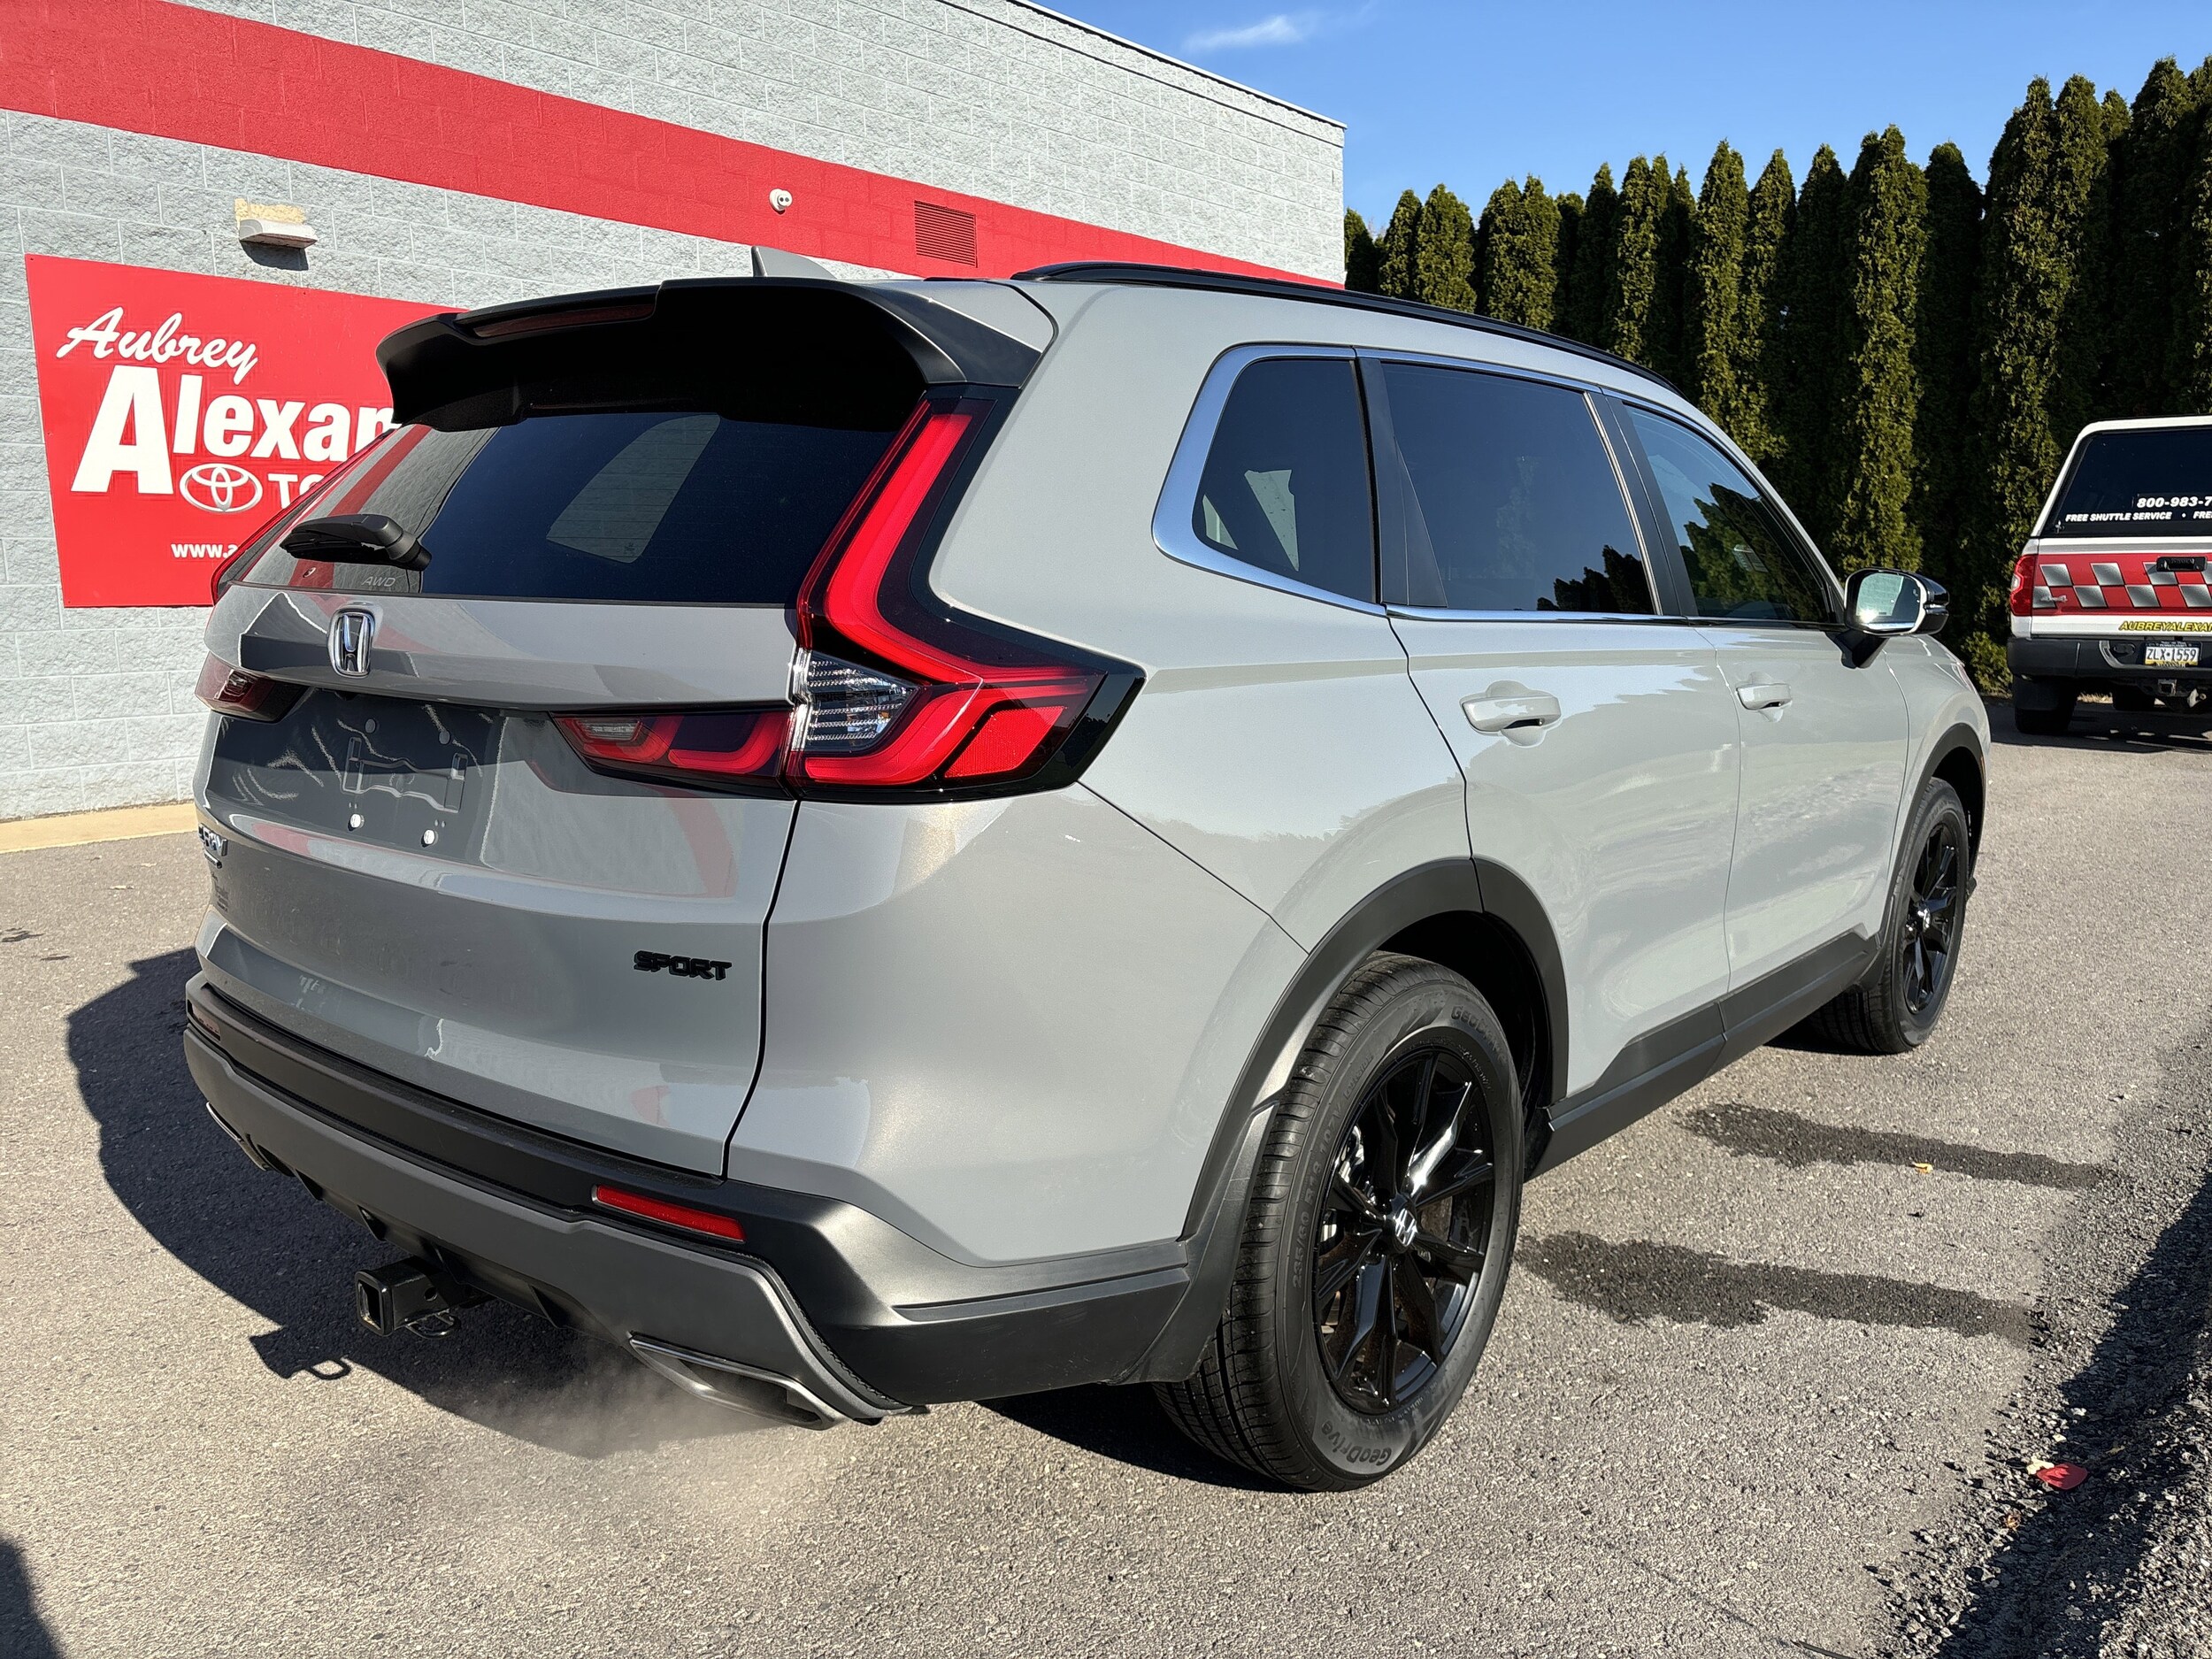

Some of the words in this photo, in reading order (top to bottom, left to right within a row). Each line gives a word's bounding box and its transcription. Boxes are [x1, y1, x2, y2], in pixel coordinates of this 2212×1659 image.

[56, 306, 258, 386] Aubrey
[2137, 496, 2212, 508] 800-983-7
[2065, 513, 2089, 522] FREE
[2090, 512, 2131, 522] SHUTTLE
[2132, 511, 2172, 520] SERVICE
[2193, 511, 2212, 519] FRE
[361, 576, 396, 587] AWD
[634, 950, 733, 981] SPORT
[1321, 1419, 1393, 1467] GeoDrive
